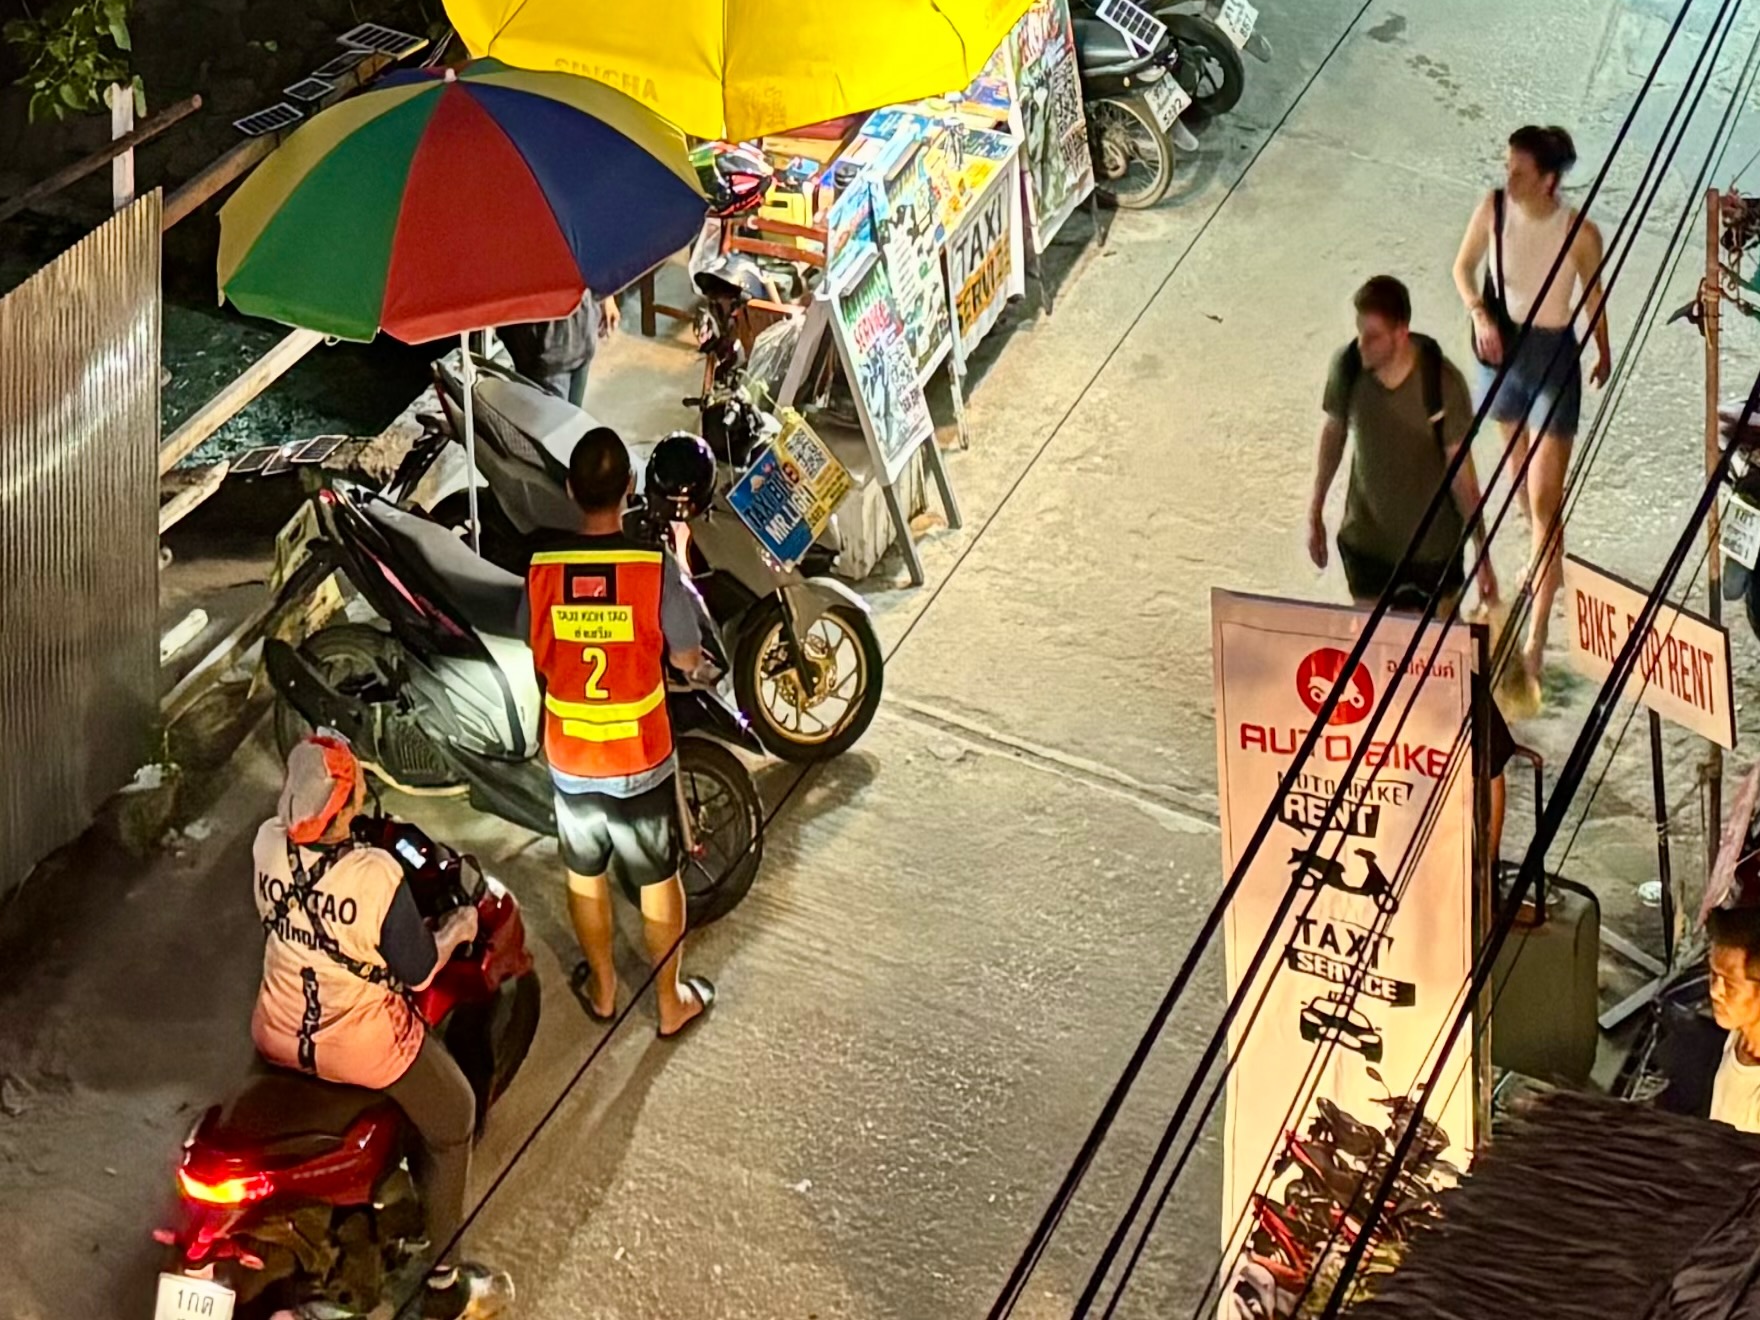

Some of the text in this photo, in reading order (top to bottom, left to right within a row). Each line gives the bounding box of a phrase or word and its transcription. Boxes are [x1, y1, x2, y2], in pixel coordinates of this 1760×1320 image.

[955, 194, 1003, 275] TAXI
[581, 646, 610, 700] 2
[1576, 588, 1616, 664] BIKE
[1667, 633, 1714, 716] RENT
[1284, 793, 1373, 835] RENT
[259, 872, 303, 906] KO
[1295, 915, 1379, 970] TAXI
